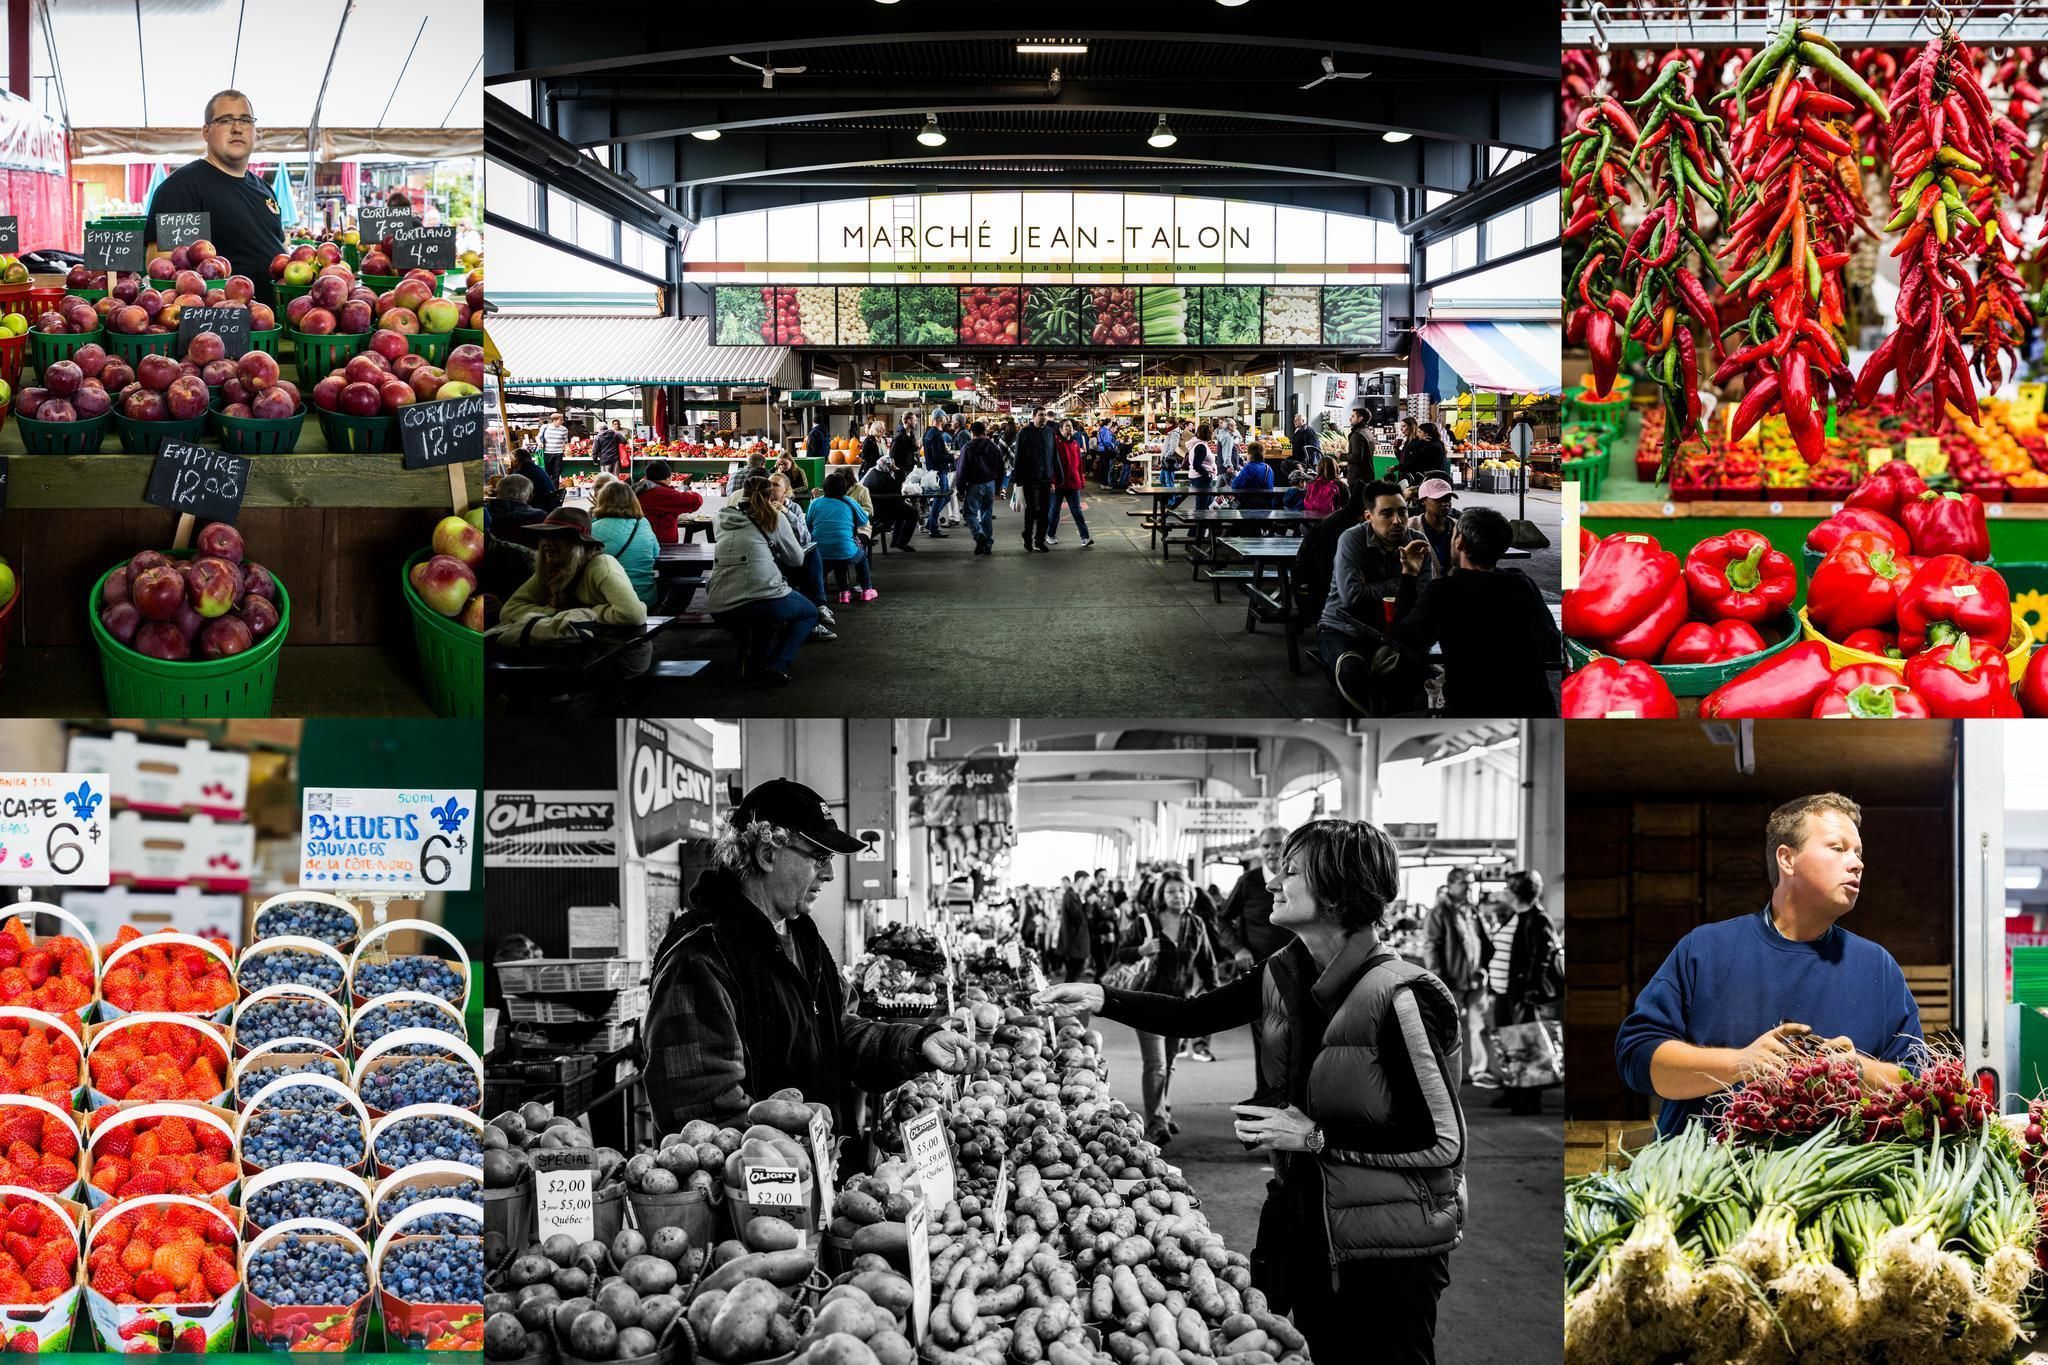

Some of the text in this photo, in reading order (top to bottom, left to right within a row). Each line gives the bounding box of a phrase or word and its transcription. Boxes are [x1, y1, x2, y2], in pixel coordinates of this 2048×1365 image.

[160, 213, 201, 226] EMPIRE
[87, 230, 134, 243] EMPIRE
[843, 220, 1250, 255] MARCHÉ JEAN-TALON
[896, 263, 1198, 273] www.marchespublics-mtl.com
[184, 308, 240, 320] EMPIRE
[912, 382, 951, 390] TANGUAY
[1140, 375, 1178, 387] FERME
[1216, 375, 1262, 387] LUSSIER
[163, 443, 241, 476] EMPIRE
[634, 744, 711, 818] OLIGNY
[965, 770, 994, 788] glace
[0, 797, 57, 818] CAPE
[488, 803, 610, 832] OLIGNY
[309, 813, 419, 841] BLEUETS
[307, 842, 386, 857] SAUVAGES
[750, 1172, 794, 1182] OLIGNY
[548, 1180, 585, 1194] $2,00
[540, 1200, 547, 1211] 3
[560, 1199, 591, 1211] $5,00
[551, 1214, 583, 1227] Québec
